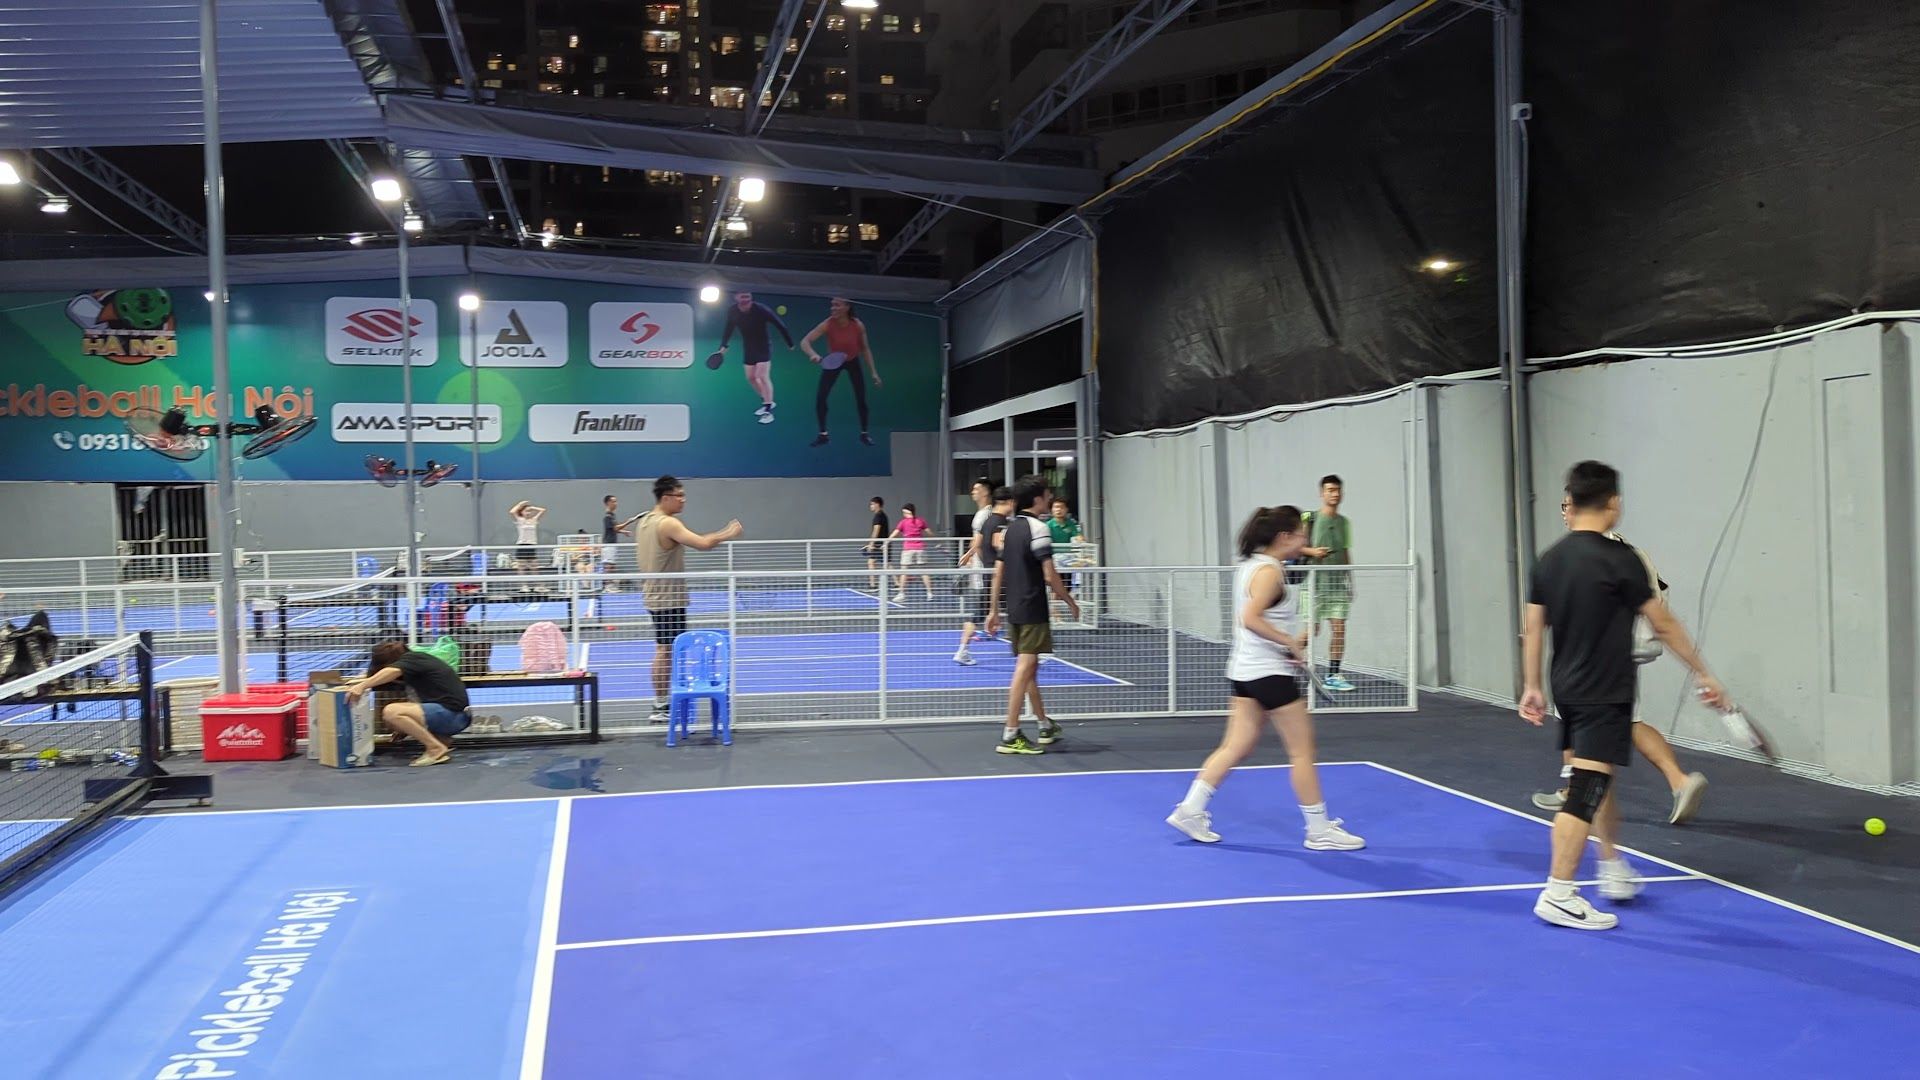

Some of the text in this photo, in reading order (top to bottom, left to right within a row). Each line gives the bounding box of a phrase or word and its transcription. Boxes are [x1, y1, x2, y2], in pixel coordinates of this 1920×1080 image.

[480, 346, 547, 358] JOOLA
[598, 350, 684, 359] GEARBOX
[155, 952, 313, 1080] Pickleball
